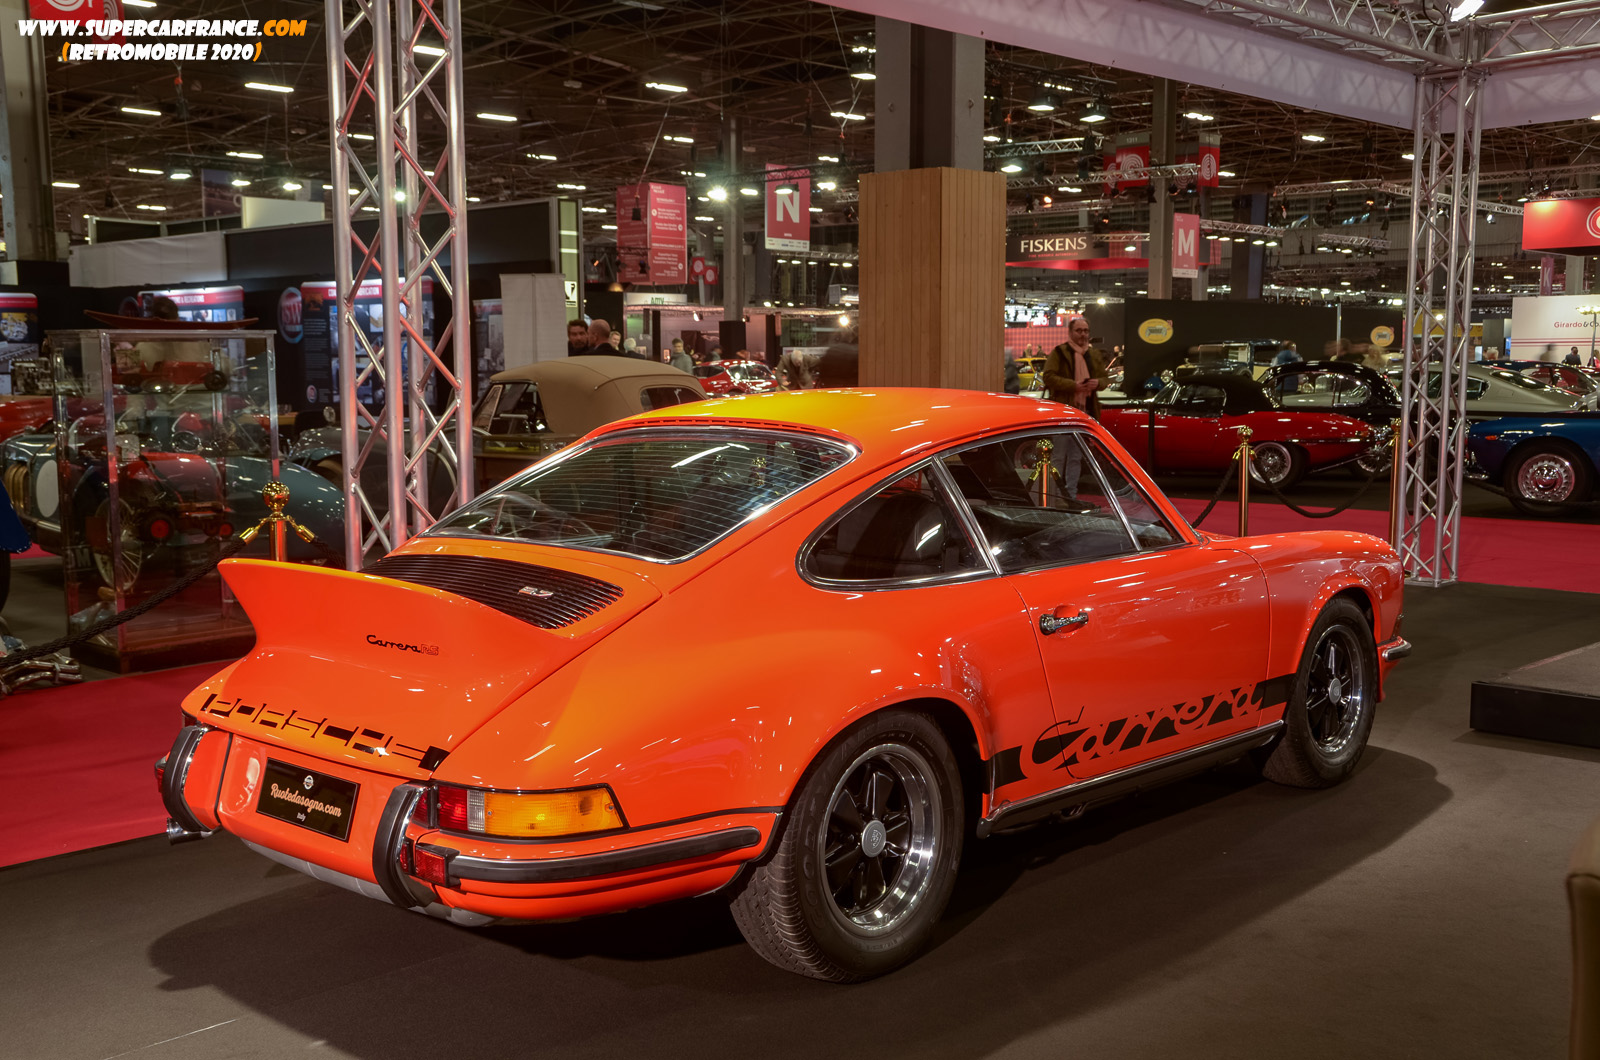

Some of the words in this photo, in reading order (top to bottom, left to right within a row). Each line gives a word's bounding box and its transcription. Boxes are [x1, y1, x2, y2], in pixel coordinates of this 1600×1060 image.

[776, 188, 800, 224] N
[1020, 236, 1087, 253] FISKENS
[1178, 228, 1195, 257] M
[1543, 267, 1551, 287] K
[1553, 321, 1583, 329] Girardo
[366, 634, 421, 653] Carrera
[420, 643, 439, 656] RS
[202, 694, 440, 769] PORSCHE
[1018, 684, 1264, 778] Carrera
[270, 783, 342, 818] Ruotedasogno.com
